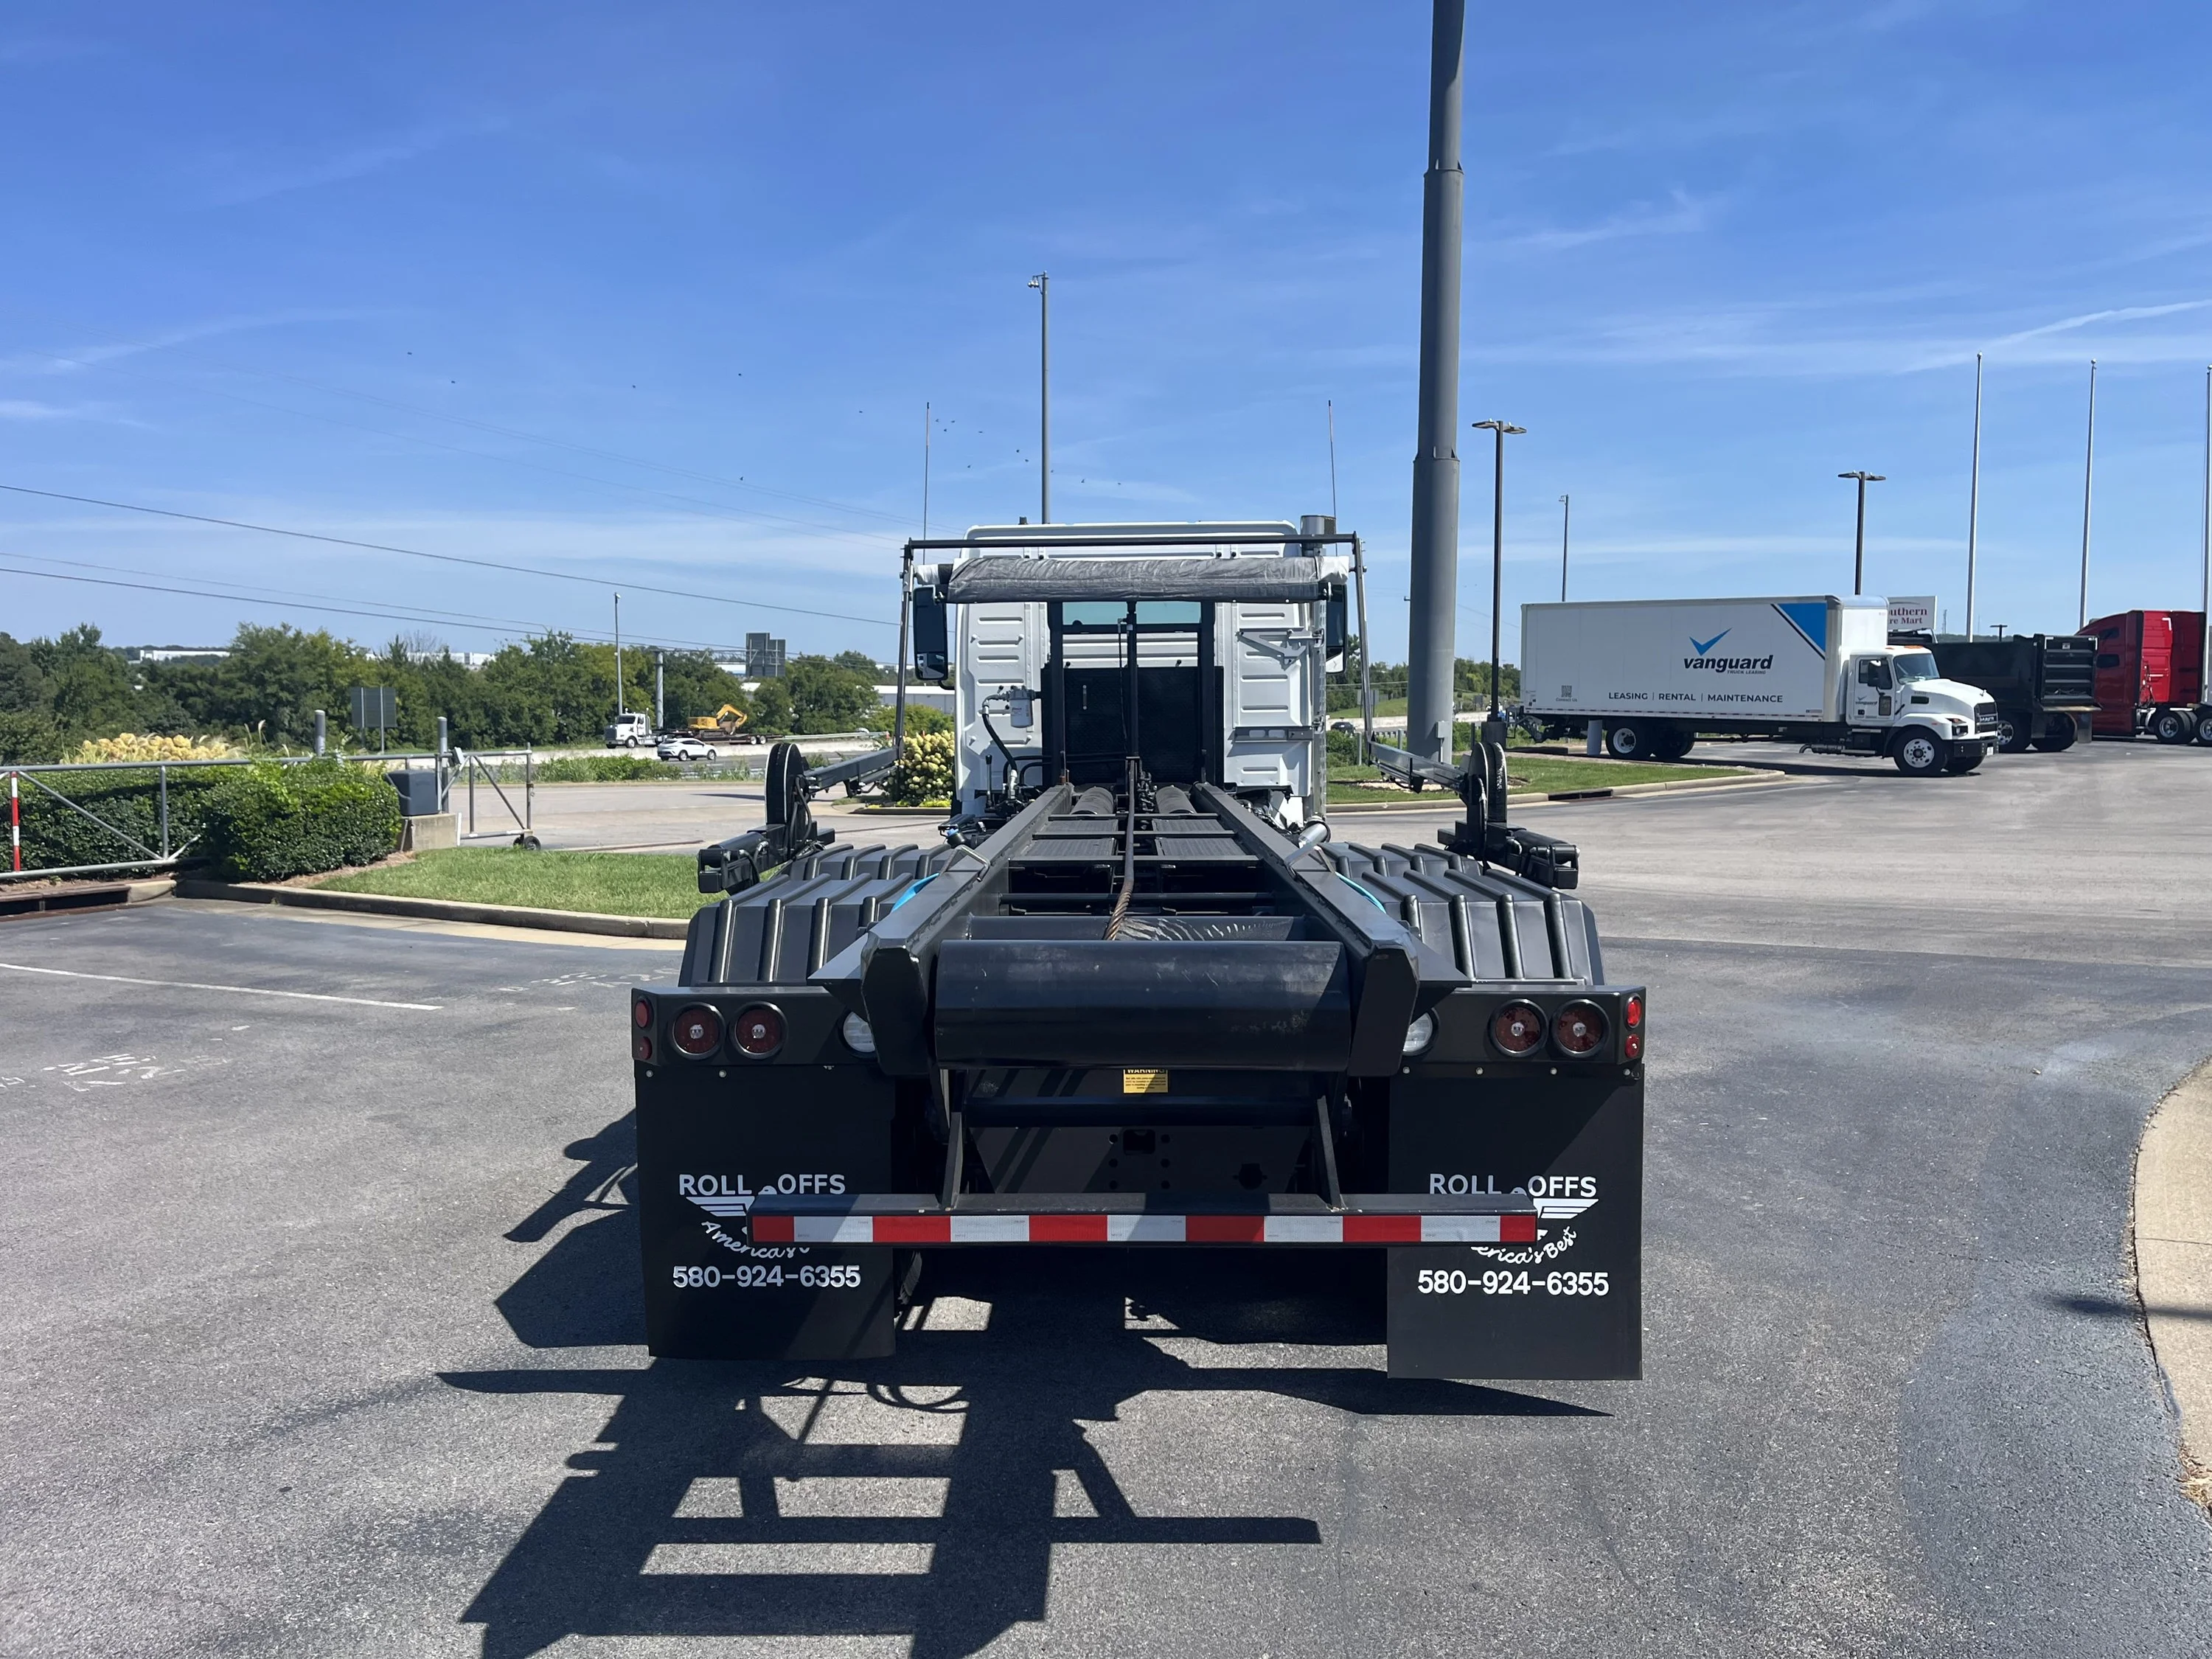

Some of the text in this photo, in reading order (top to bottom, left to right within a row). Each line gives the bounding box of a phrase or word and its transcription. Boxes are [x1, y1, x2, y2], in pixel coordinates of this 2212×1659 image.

[1889, 608, 1927, 616] uthern
[1683, 654, 1774, 673] vanguard
[1608, 692, 1784, 703] LEASING RENTAL MAINTENANCE
[678, 1174, 846, 1195] ROLL OFFS
[1429, 1173, 1597, 1197] ROLL OFFS
[701, 1221, 796, 1259] Americas
[1543, 1225, 1577, 1259] Best
[672, 1265, 862, 1289] 580-924-6355
[1417, 1268, 1610, 1296] 580-924-6355
